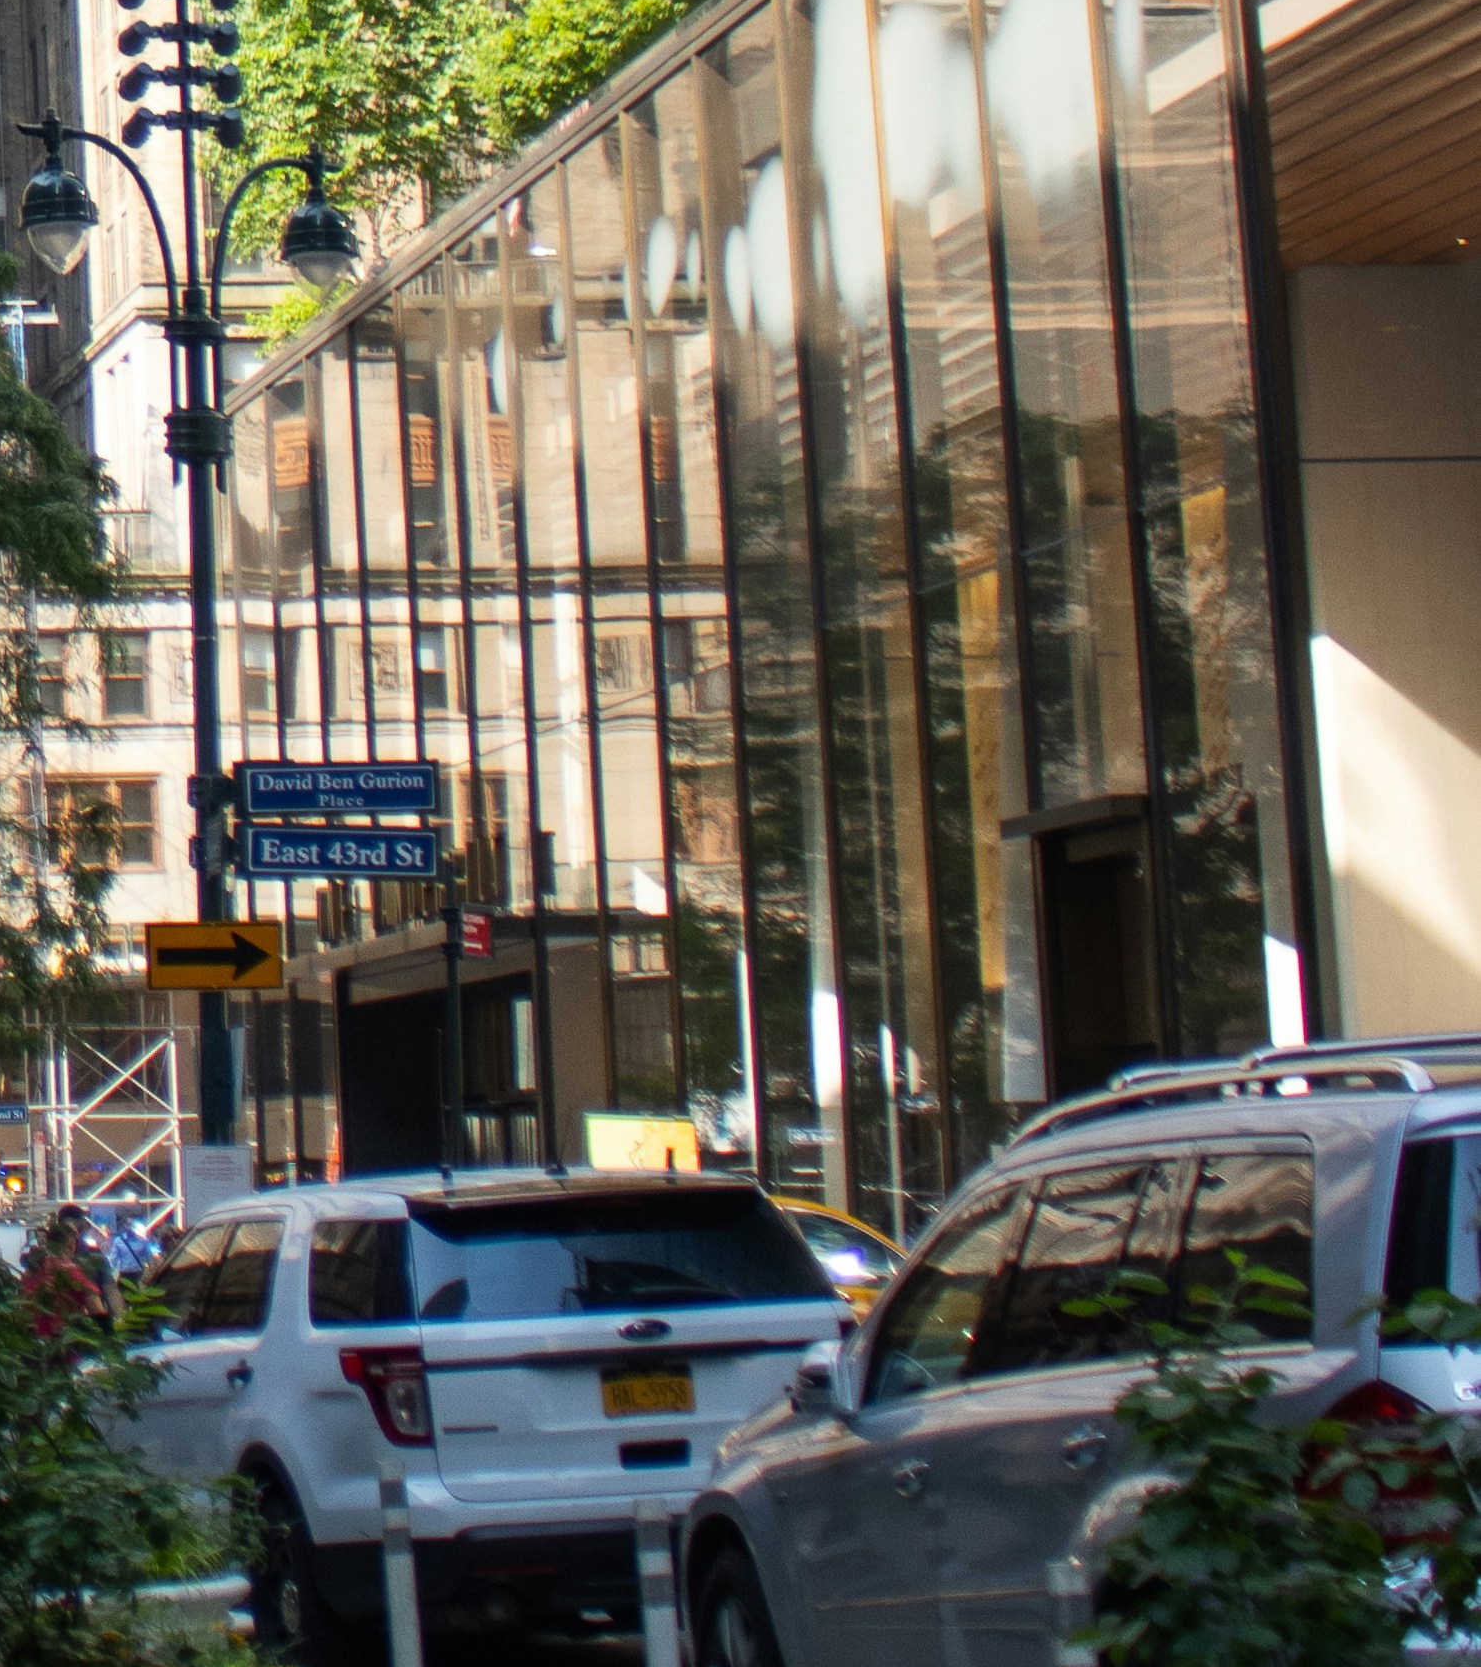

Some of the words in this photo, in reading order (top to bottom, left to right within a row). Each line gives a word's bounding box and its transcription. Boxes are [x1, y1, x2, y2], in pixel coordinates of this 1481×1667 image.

[257, 773, 313, 791] David
[317, 772, 354, 790] Ben
[359, 771, 425, 789] Gurion
[319, 794, 365, 807] Place
[261, 838, 320, 865] East
[327, 841, 388, 866] 43rd
[395, 842, 425, 867] St
[12, 1109, 24, 1120] St
